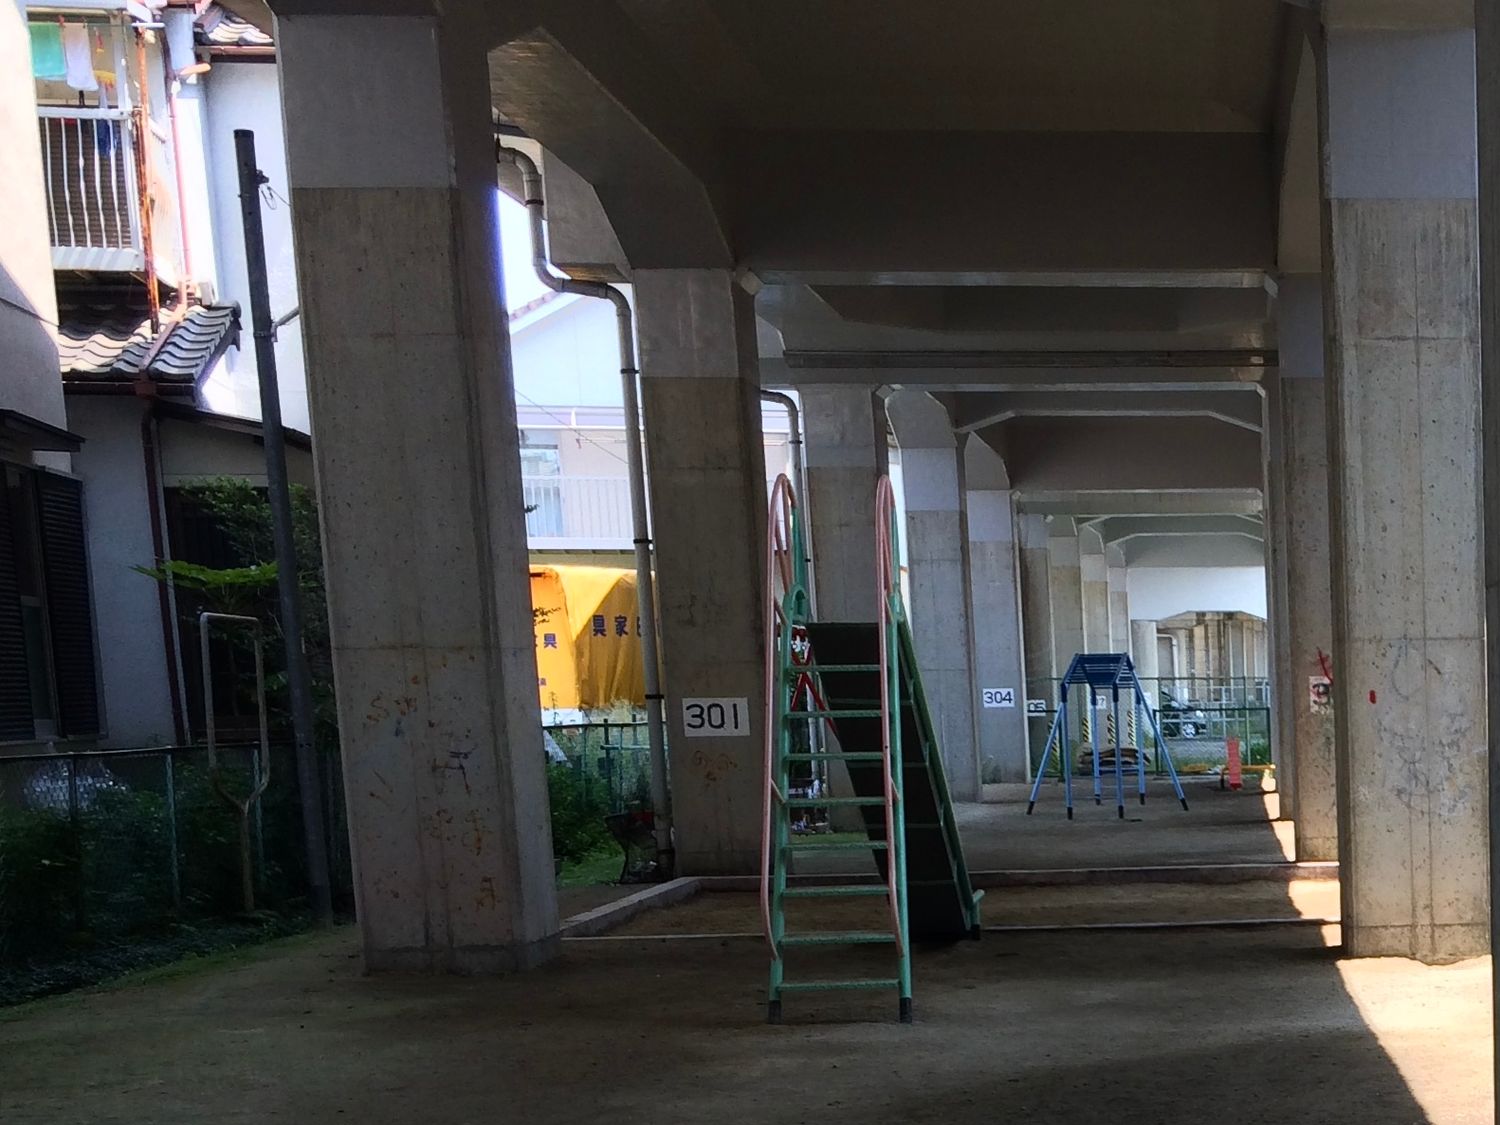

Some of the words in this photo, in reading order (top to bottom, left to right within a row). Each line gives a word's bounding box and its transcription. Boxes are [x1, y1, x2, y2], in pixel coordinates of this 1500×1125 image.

[983, 690, 1013, 705] 304
[1027, 702, 1046, 713] 05
[685, 702, 739, 730] 301
